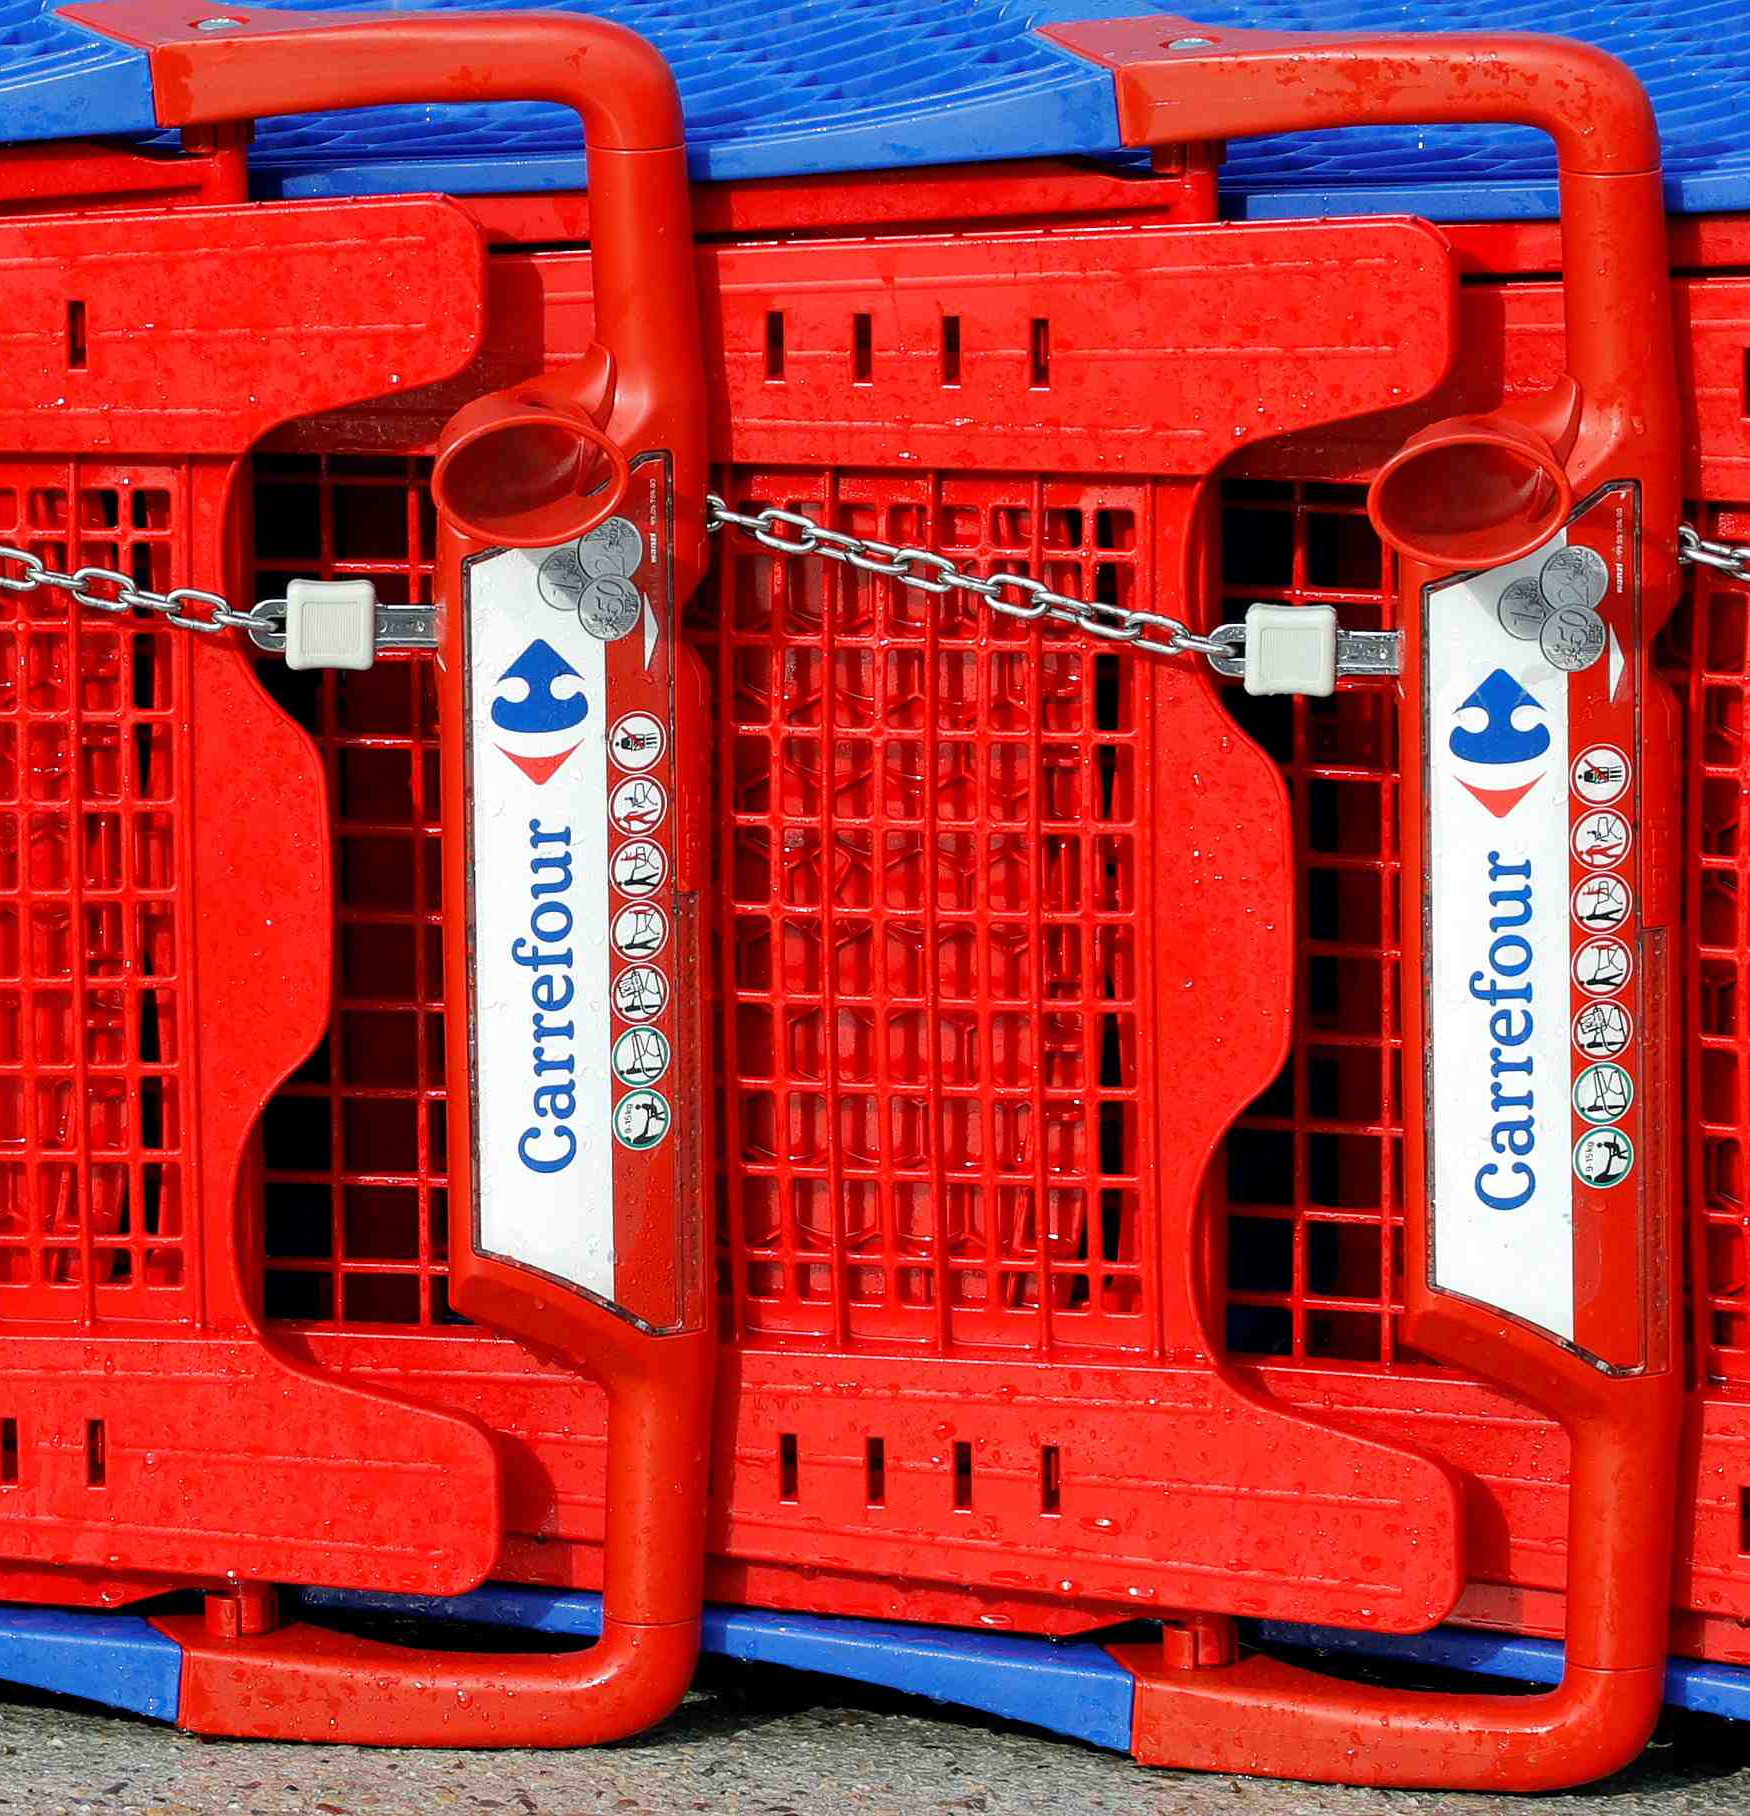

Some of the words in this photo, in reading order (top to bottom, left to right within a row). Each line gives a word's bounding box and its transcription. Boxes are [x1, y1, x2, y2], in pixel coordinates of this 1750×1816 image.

[649, 532, 658, 564] wanzl
[1615, 562, 1624, 594] wanzl
[594, 579, 623, 613] 50
[1559, 613, 1588, 643] 50
[511, 819, 579, 1174] Carrefour
[1468, 850, 1537, 1212] Carrefour
